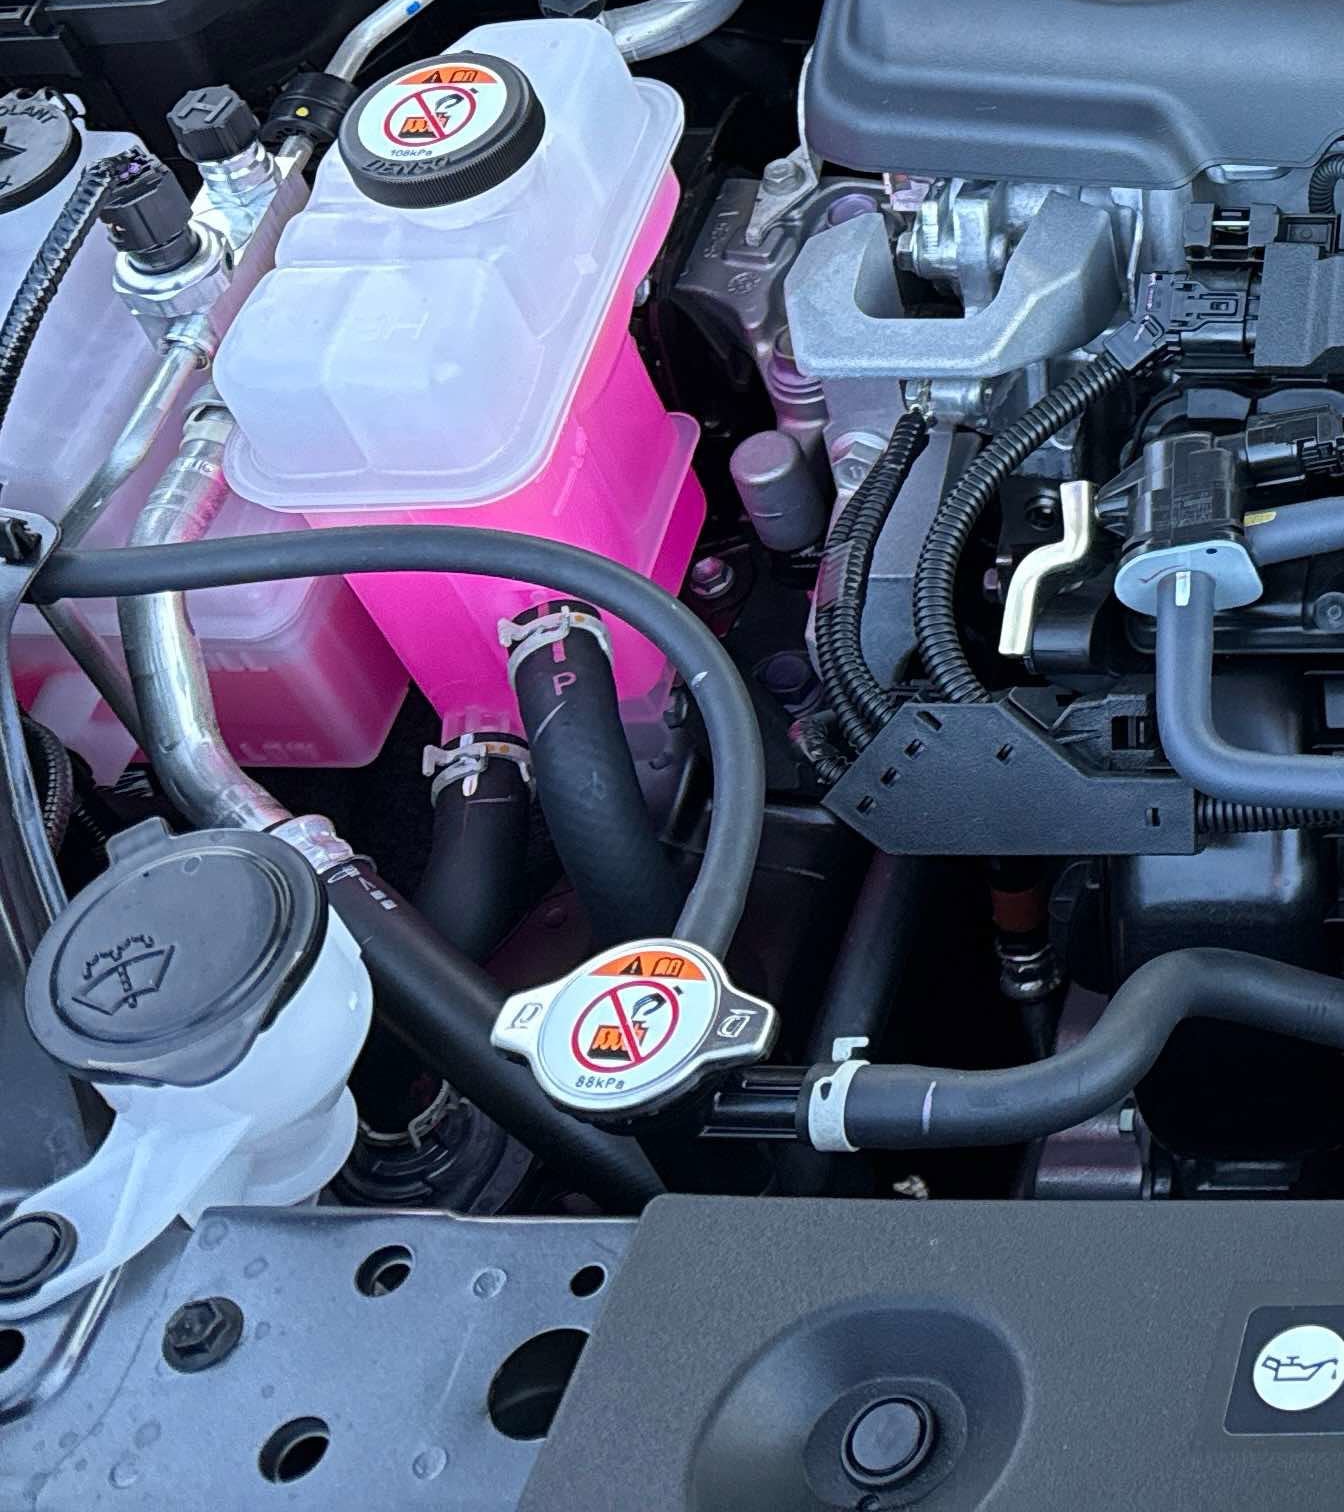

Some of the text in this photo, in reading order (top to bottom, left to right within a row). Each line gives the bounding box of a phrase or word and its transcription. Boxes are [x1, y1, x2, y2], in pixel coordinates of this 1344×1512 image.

[178, 93, 233, 124] H
[390, 148, 433, 157] 108kPa
[361, 156, 451, 177] DENSO
[552, 671, 577, 696] P
[575, 1075, 626, 1090] 88kPa
